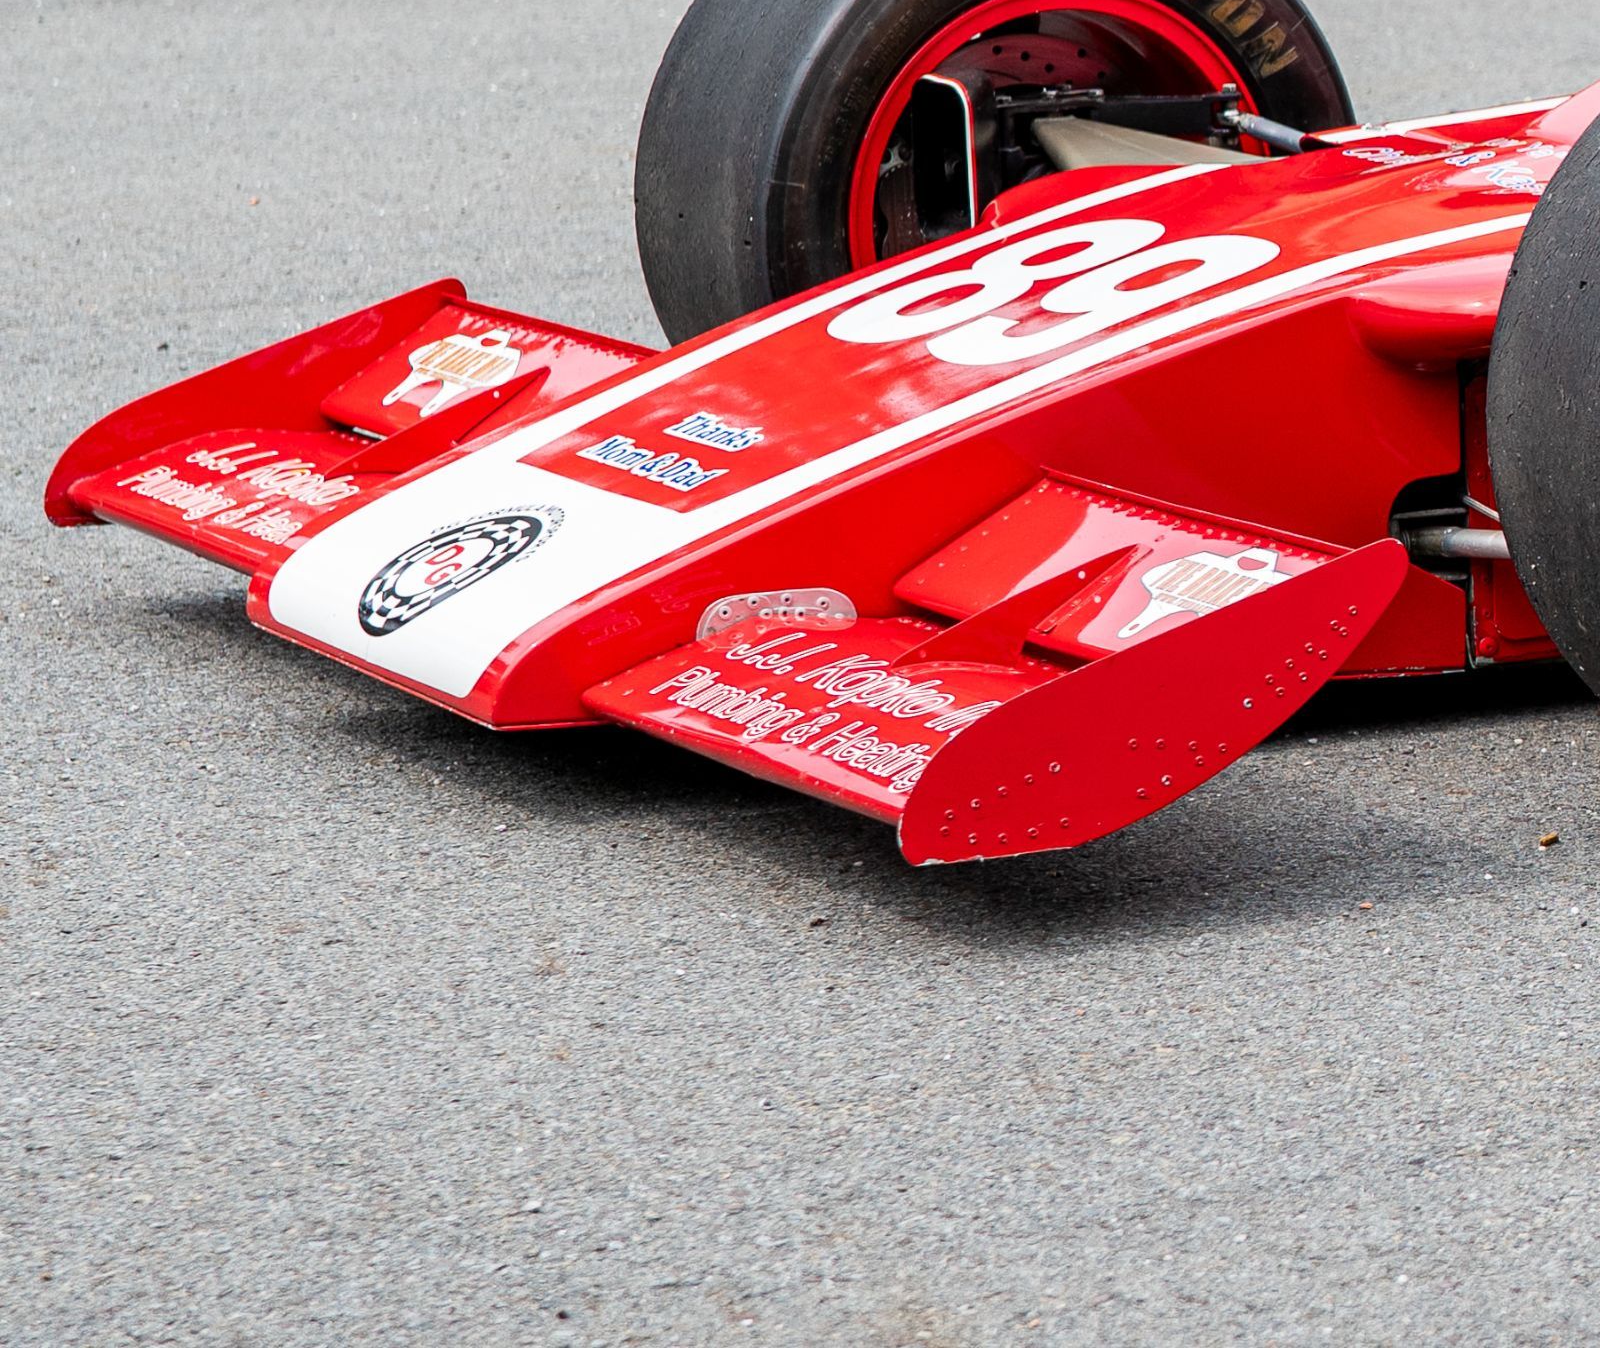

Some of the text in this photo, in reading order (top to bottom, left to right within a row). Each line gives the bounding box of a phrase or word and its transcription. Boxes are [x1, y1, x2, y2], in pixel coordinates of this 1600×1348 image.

[827, 218, 1281, 365] 89
[186, 443, 279, 474] J.J.
[666, 412, 763, 451] Thanks
[581, 436, 726, 490] Mom & Dad
[116, 464, 237, 521] Plumbing
[649, 666, 804, 741] Plumbing
[725, 632, 838, 675] J.J.
[794, 653, 955, 719] Kopko
[781, 712, 841, 745] &
[807, 721, 931, 794] Heating
